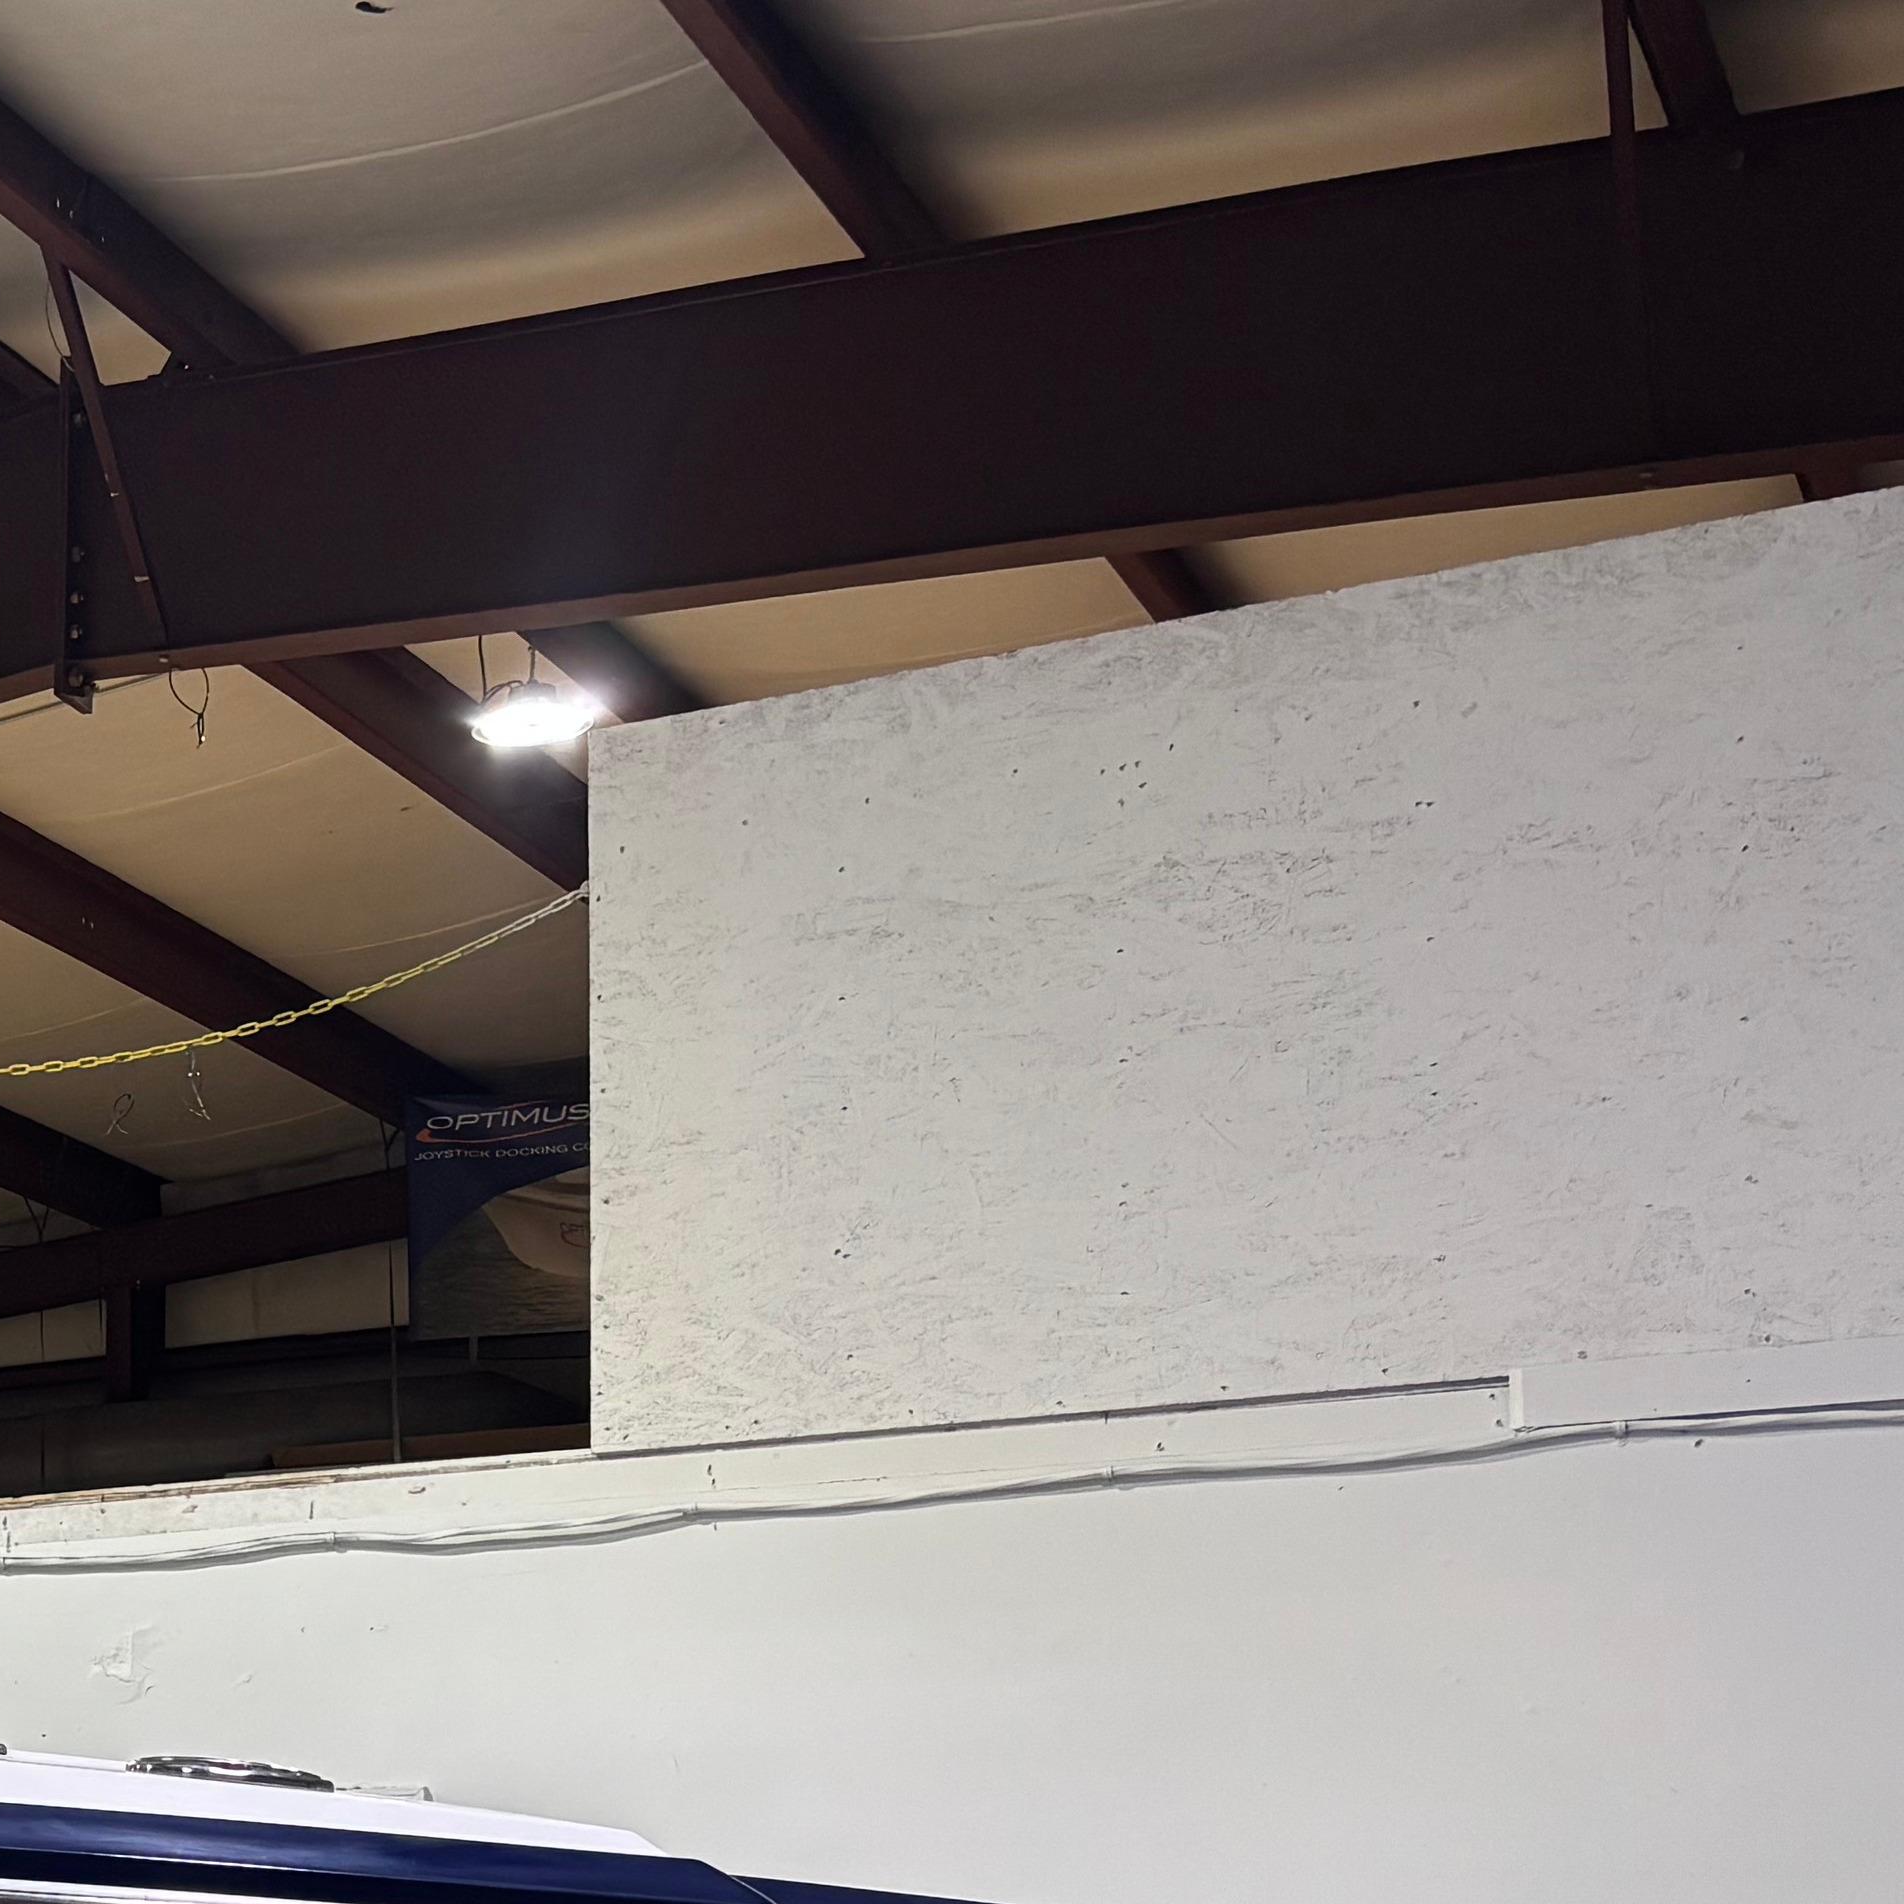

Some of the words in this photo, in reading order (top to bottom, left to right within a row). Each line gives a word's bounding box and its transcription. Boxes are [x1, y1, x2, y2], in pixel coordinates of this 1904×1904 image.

[427, 1103, 590, 1131] OPTIMUS
[413, 1148, 491, 1162] JOYSTICK
[495, 1144, 569, 1159] DOCKING
